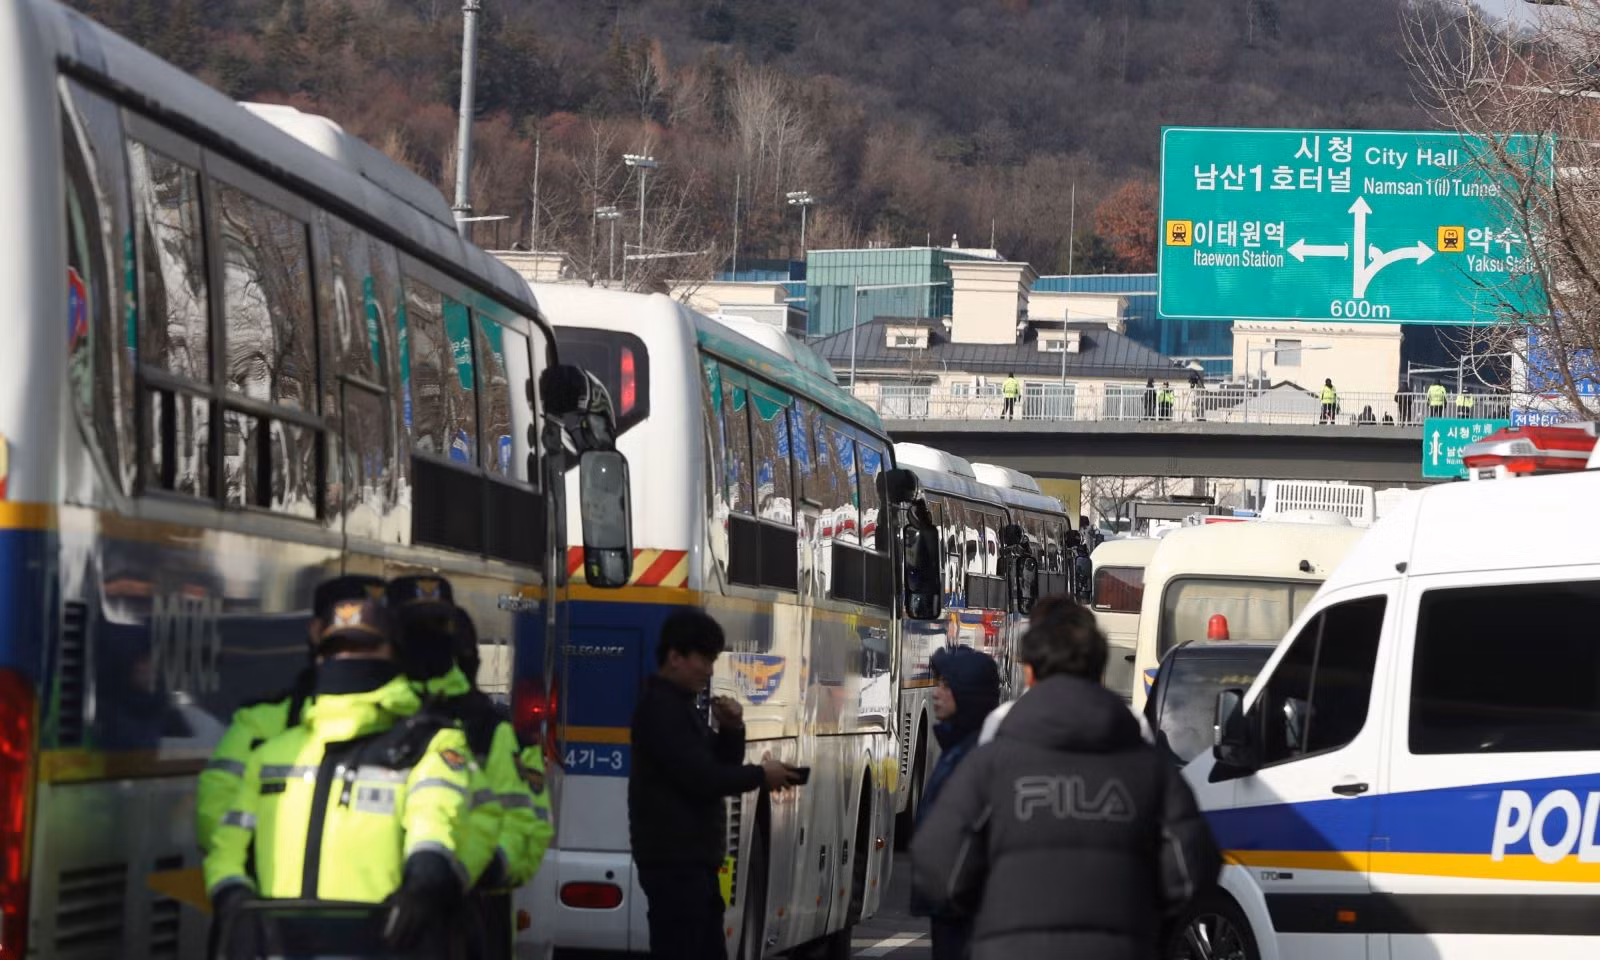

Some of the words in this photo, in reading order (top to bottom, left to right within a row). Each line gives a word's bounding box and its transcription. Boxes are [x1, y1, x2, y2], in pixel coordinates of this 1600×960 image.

[1294, 135, 1353, 163] 시청
[1365, 147, 1408, 169] City
[1416, 148, 1458, 166] Hall
[1194, 163, 1351, 193] 남산1호터널
[1364, 177, 1423, 195] Namsan
[1427, 178, 1450, 197] 1(il)
[1454, 178, 1502, 197] Tunne
[1193, 219, 1285, 248] 이태원역
[1467, 226, 1524, 255] 약수
[1193, 248, 1240, 267] Itaewon
[1242, 249, 1284, 267] Station
[1466, 254, 1504, 273] Yaksu
[1330, 299, 1390, 319] 600m
[1447, 426, 1470, 439] 시청
[1014, 775, 1138, 820] FILA
[1490, 788, 1600, 864] POL
